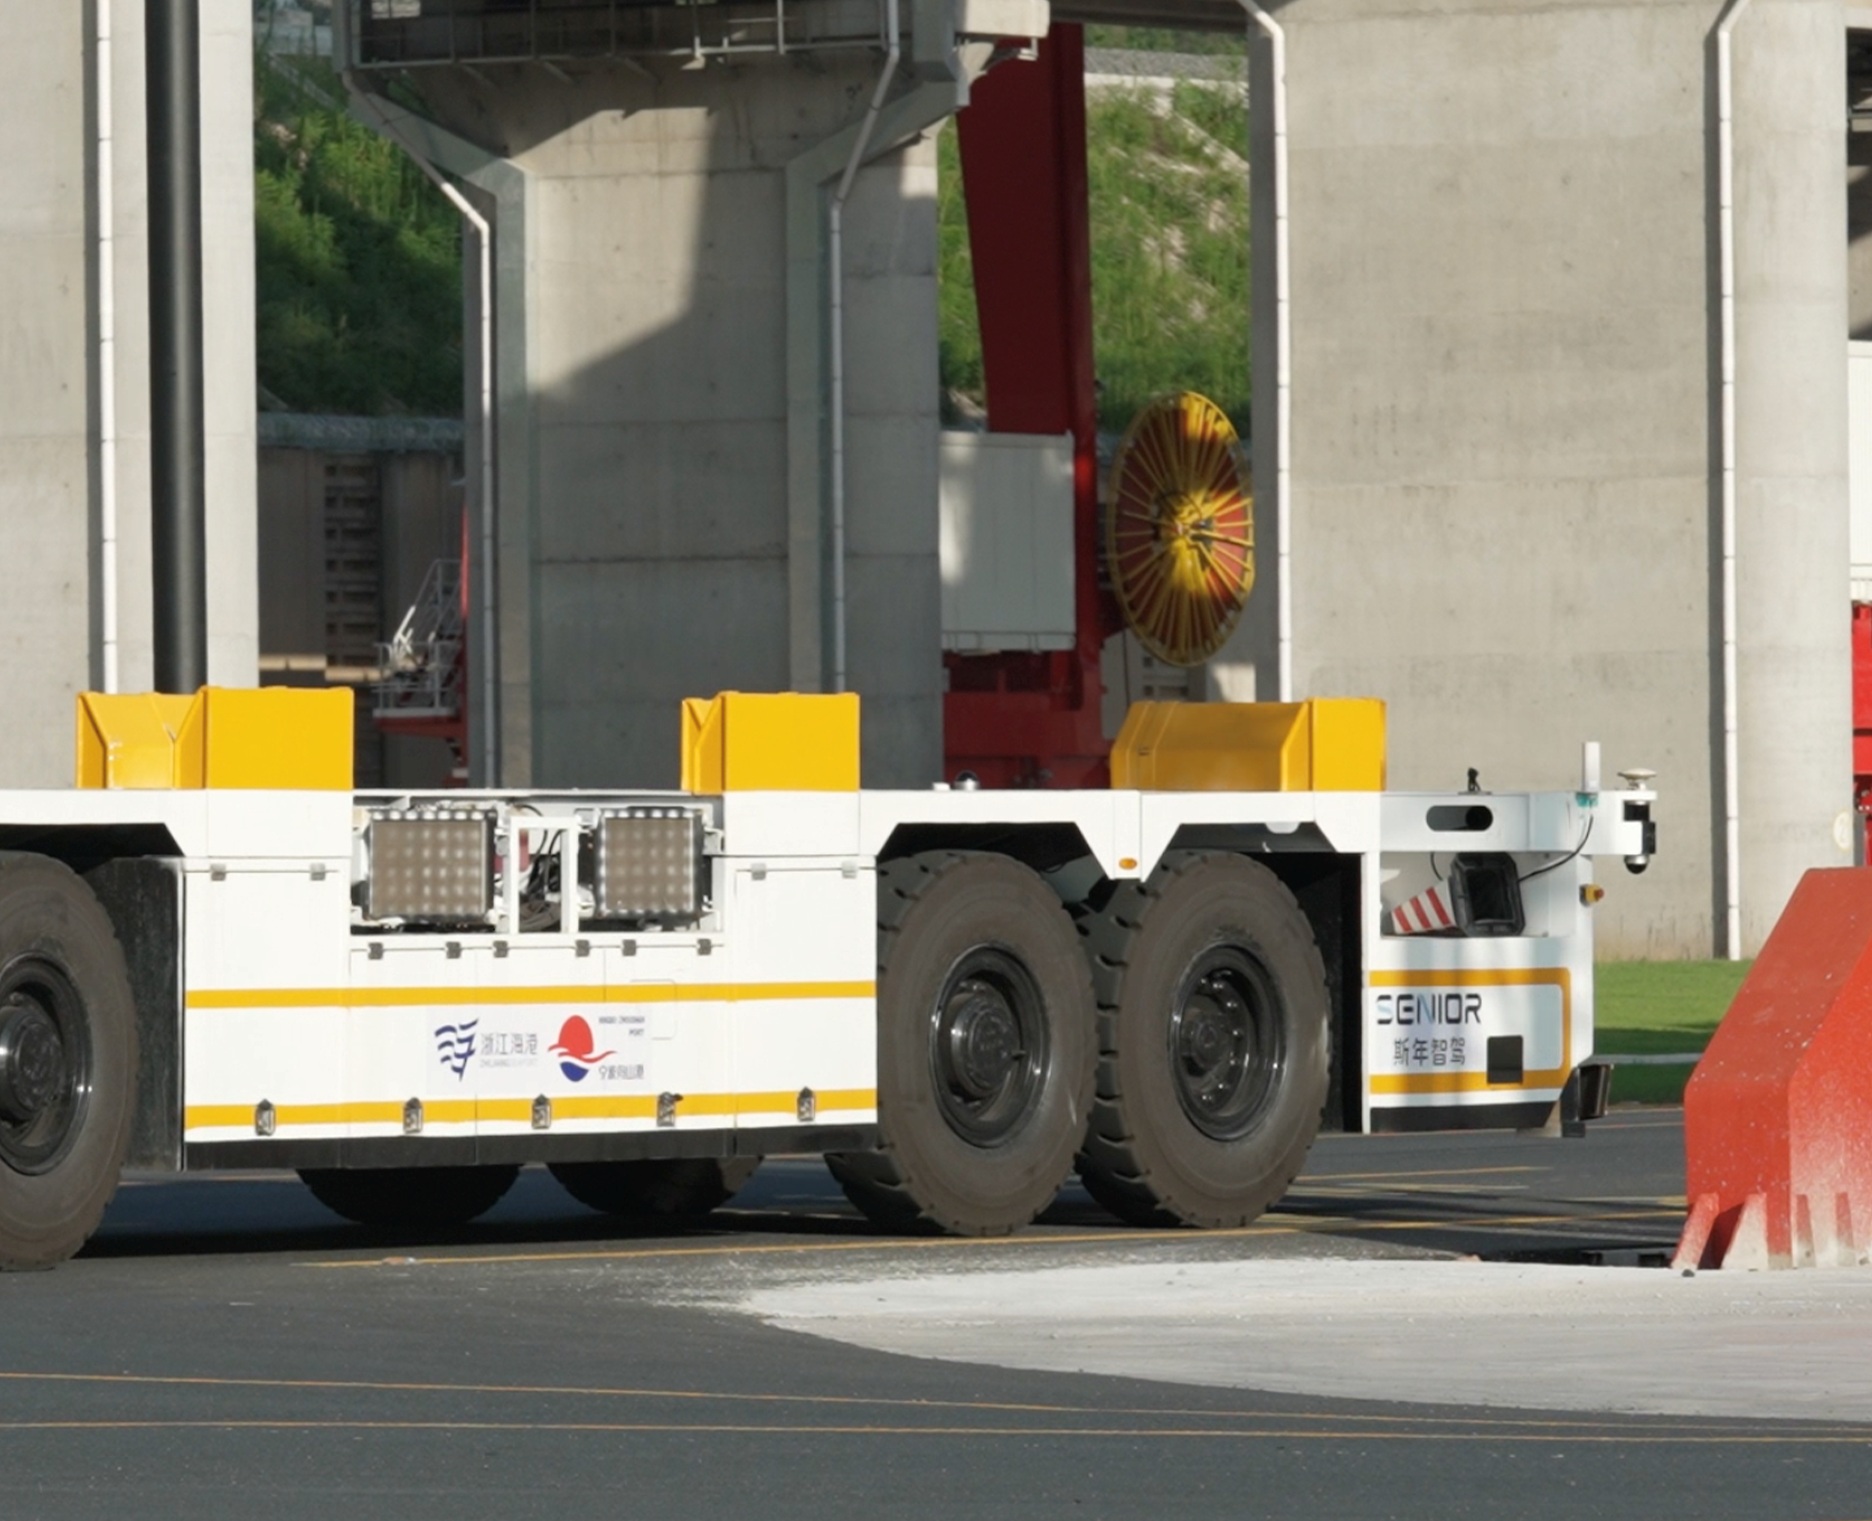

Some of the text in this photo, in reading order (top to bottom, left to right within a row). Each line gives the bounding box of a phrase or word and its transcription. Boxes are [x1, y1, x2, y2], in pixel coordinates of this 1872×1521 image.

[1376, 993, 1482, 1026] SENIOR
[1393, 1036, 1466, 1067] 斯年智驾
